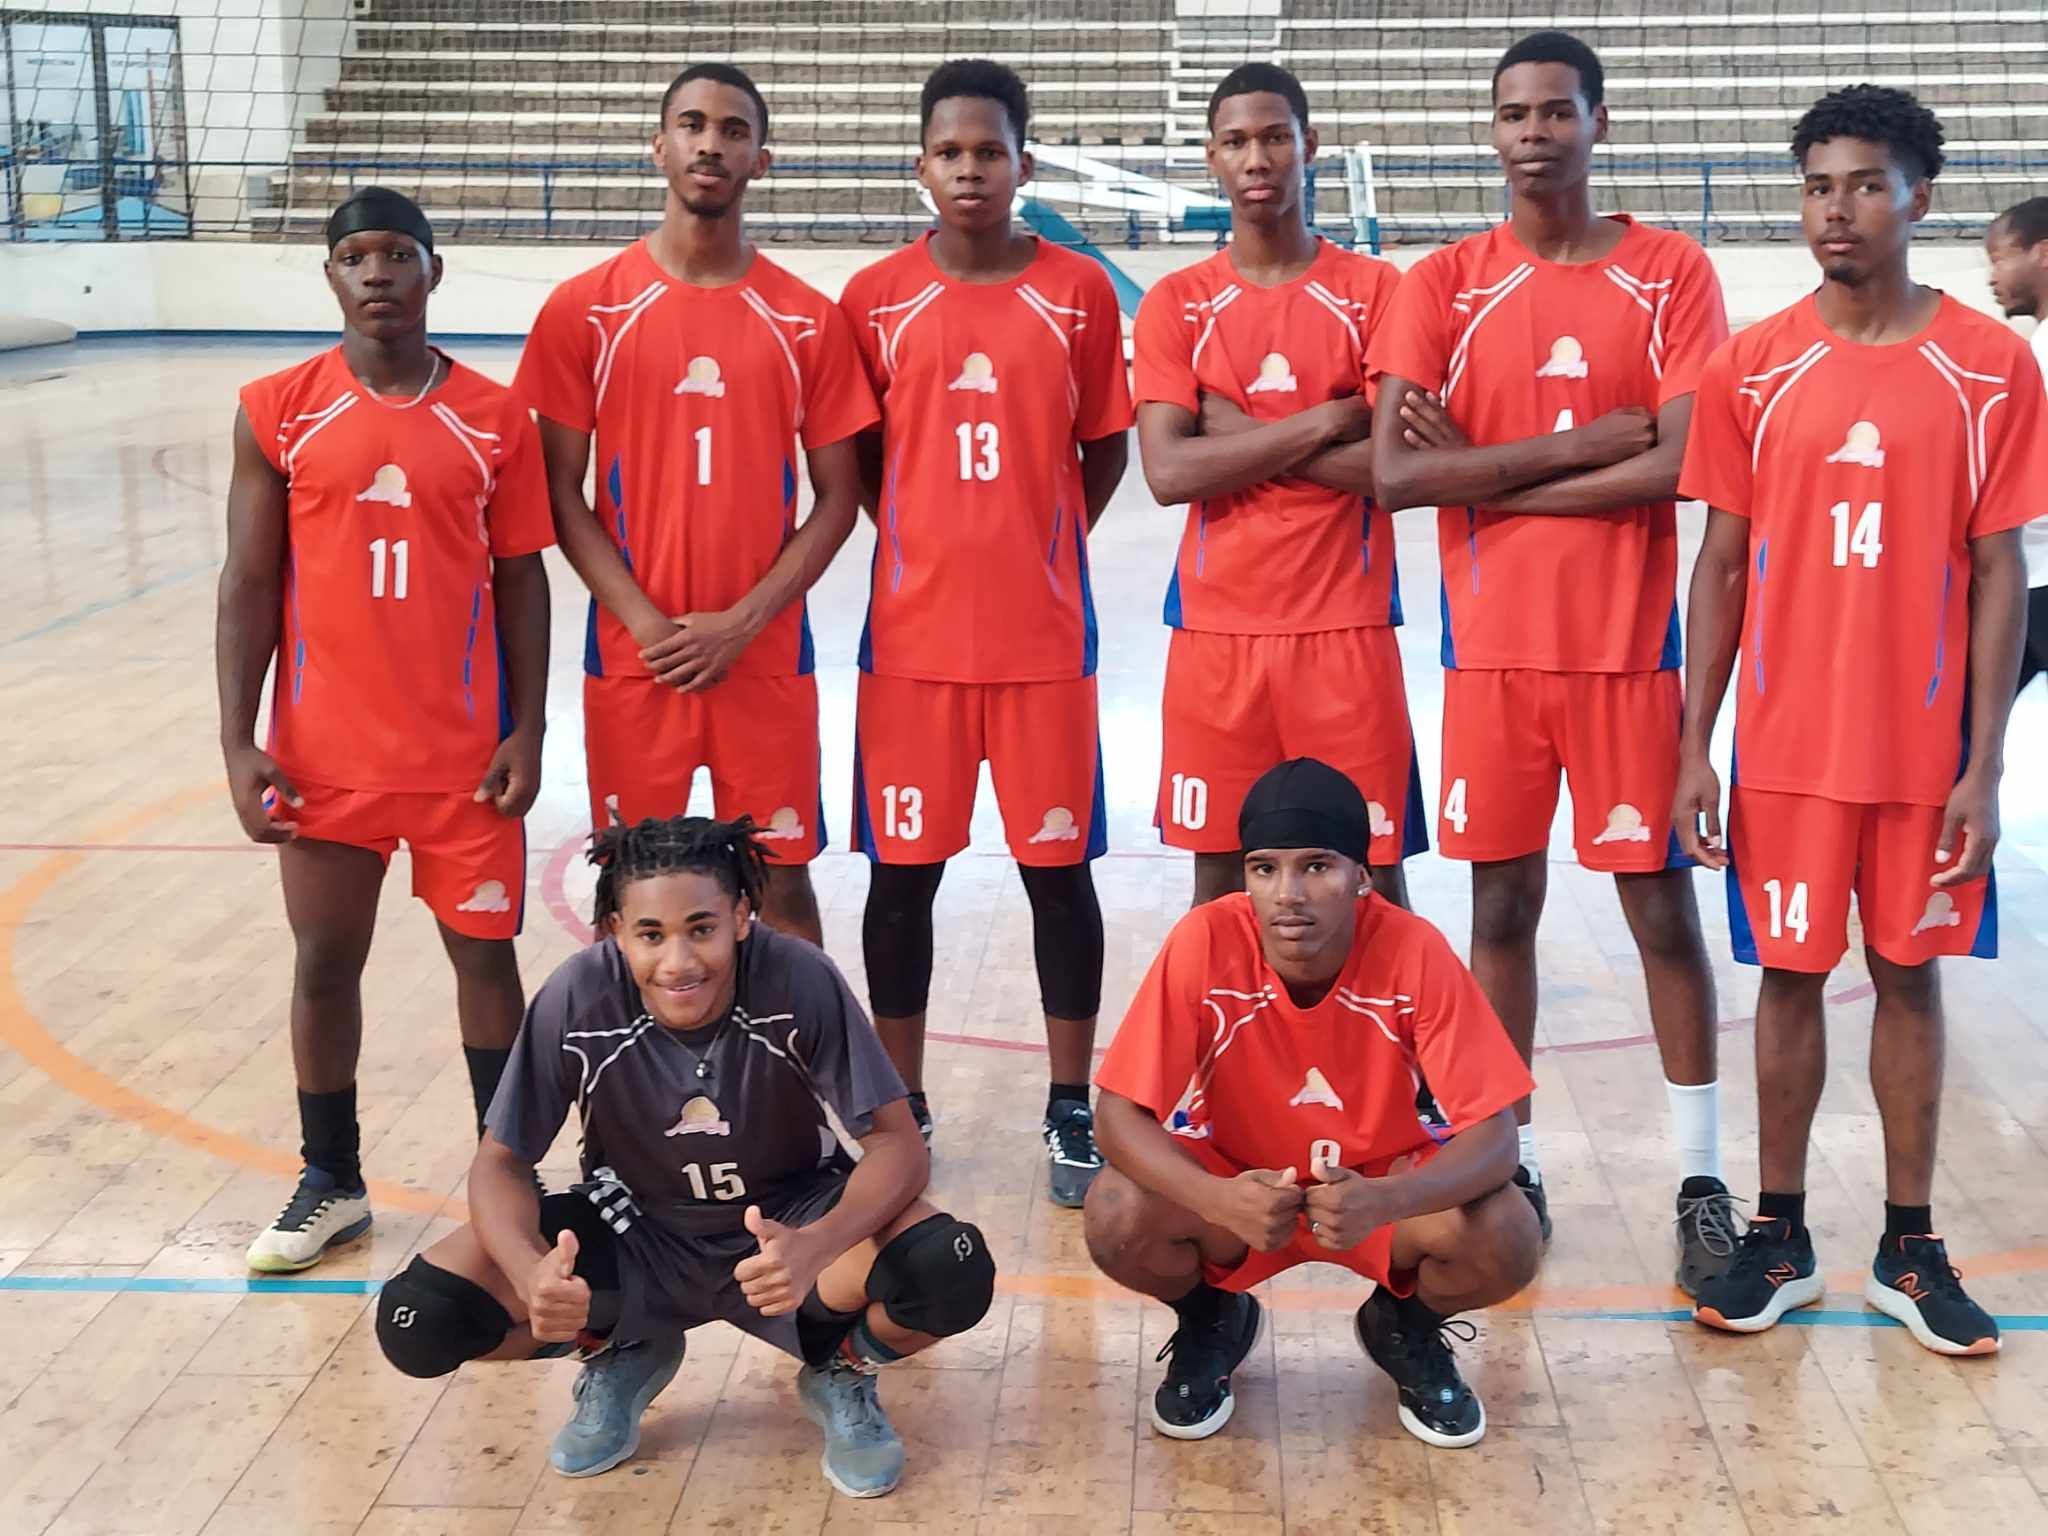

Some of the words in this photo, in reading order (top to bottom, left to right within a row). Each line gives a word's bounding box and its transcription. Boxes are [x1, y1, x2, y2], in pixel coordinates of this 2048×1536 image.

[694, 426, 712, 486] 1
[955, 421, 1001, 481] 13
[1829, 501, 1883, 568] 14
[369, 538, 409, 599] 11
[882, 785, 923, 841] 13
[1171, 772, 1208, 830] 10
[1443, 778, 1468, 834] 4
[1763, 879, 1810, 944] 14
[681, 1162, 746, 1200] 15
